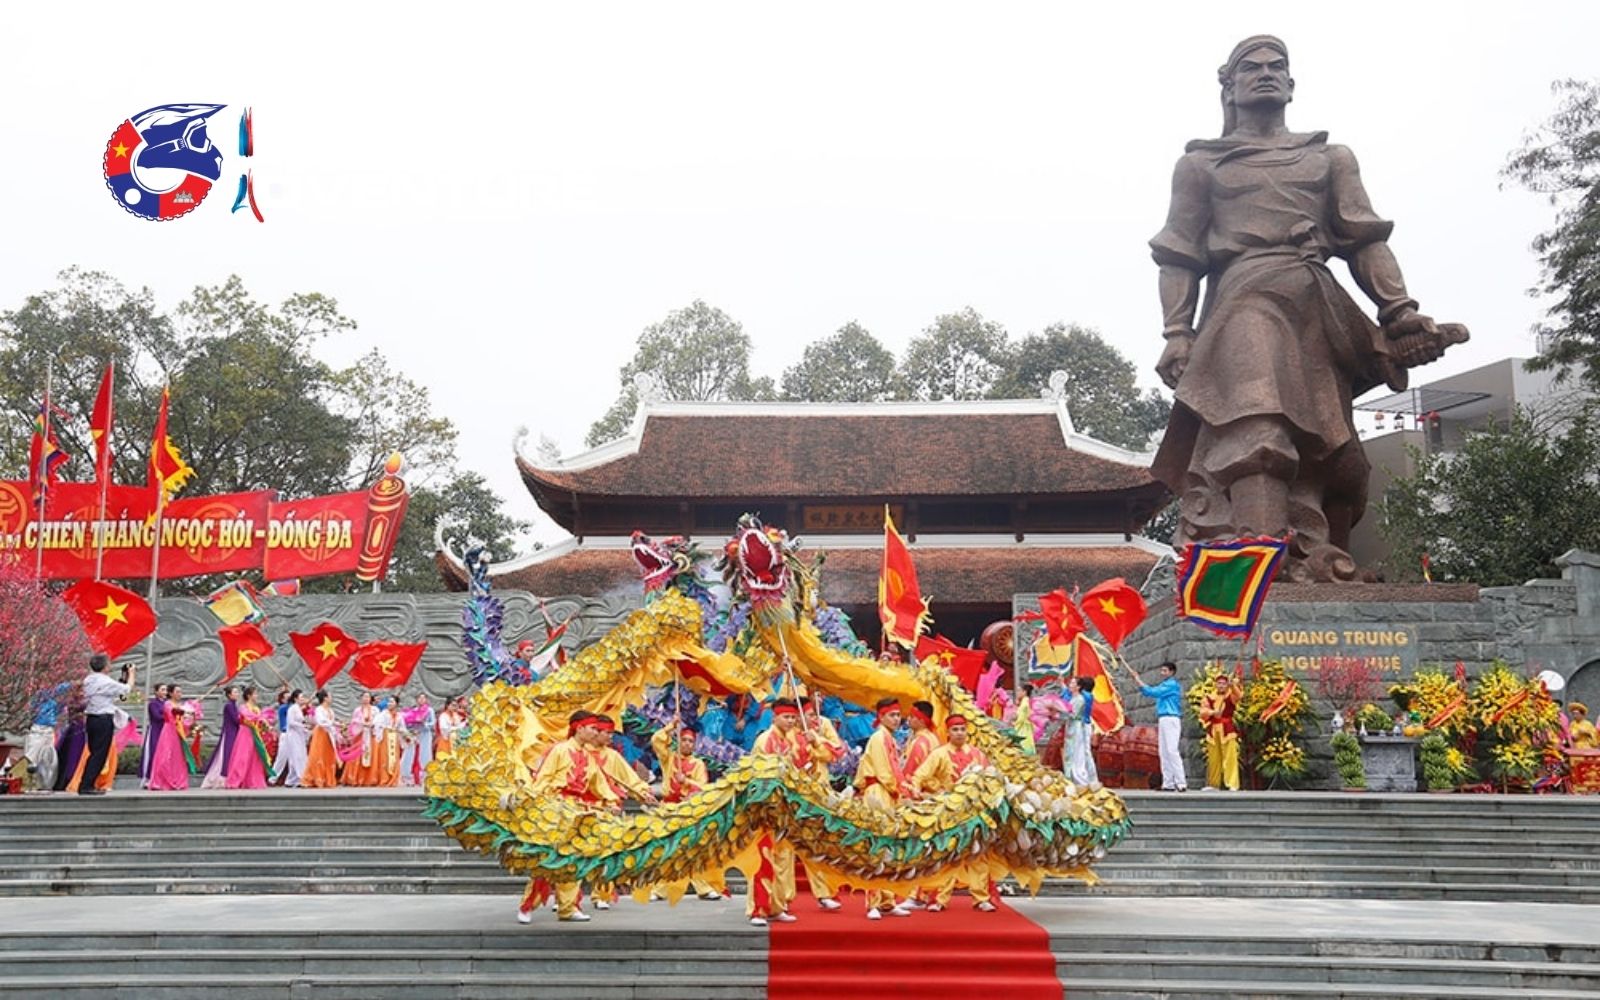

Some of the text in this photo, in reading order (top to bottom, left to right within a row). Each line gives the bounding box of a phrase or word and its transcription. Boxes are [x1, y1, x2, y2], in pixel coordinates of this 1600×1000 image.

[25, 511, 87, 549] CHIẾN
[161, 518, 215, 553] NGỌC
[267, 510, 322, 548] ĐỐNG
[326, 519, 353, 548] ĐA
[1271, 630, 1409, 646] QUANG TRUNG
[1281, 651, 1359, 670] NGU
